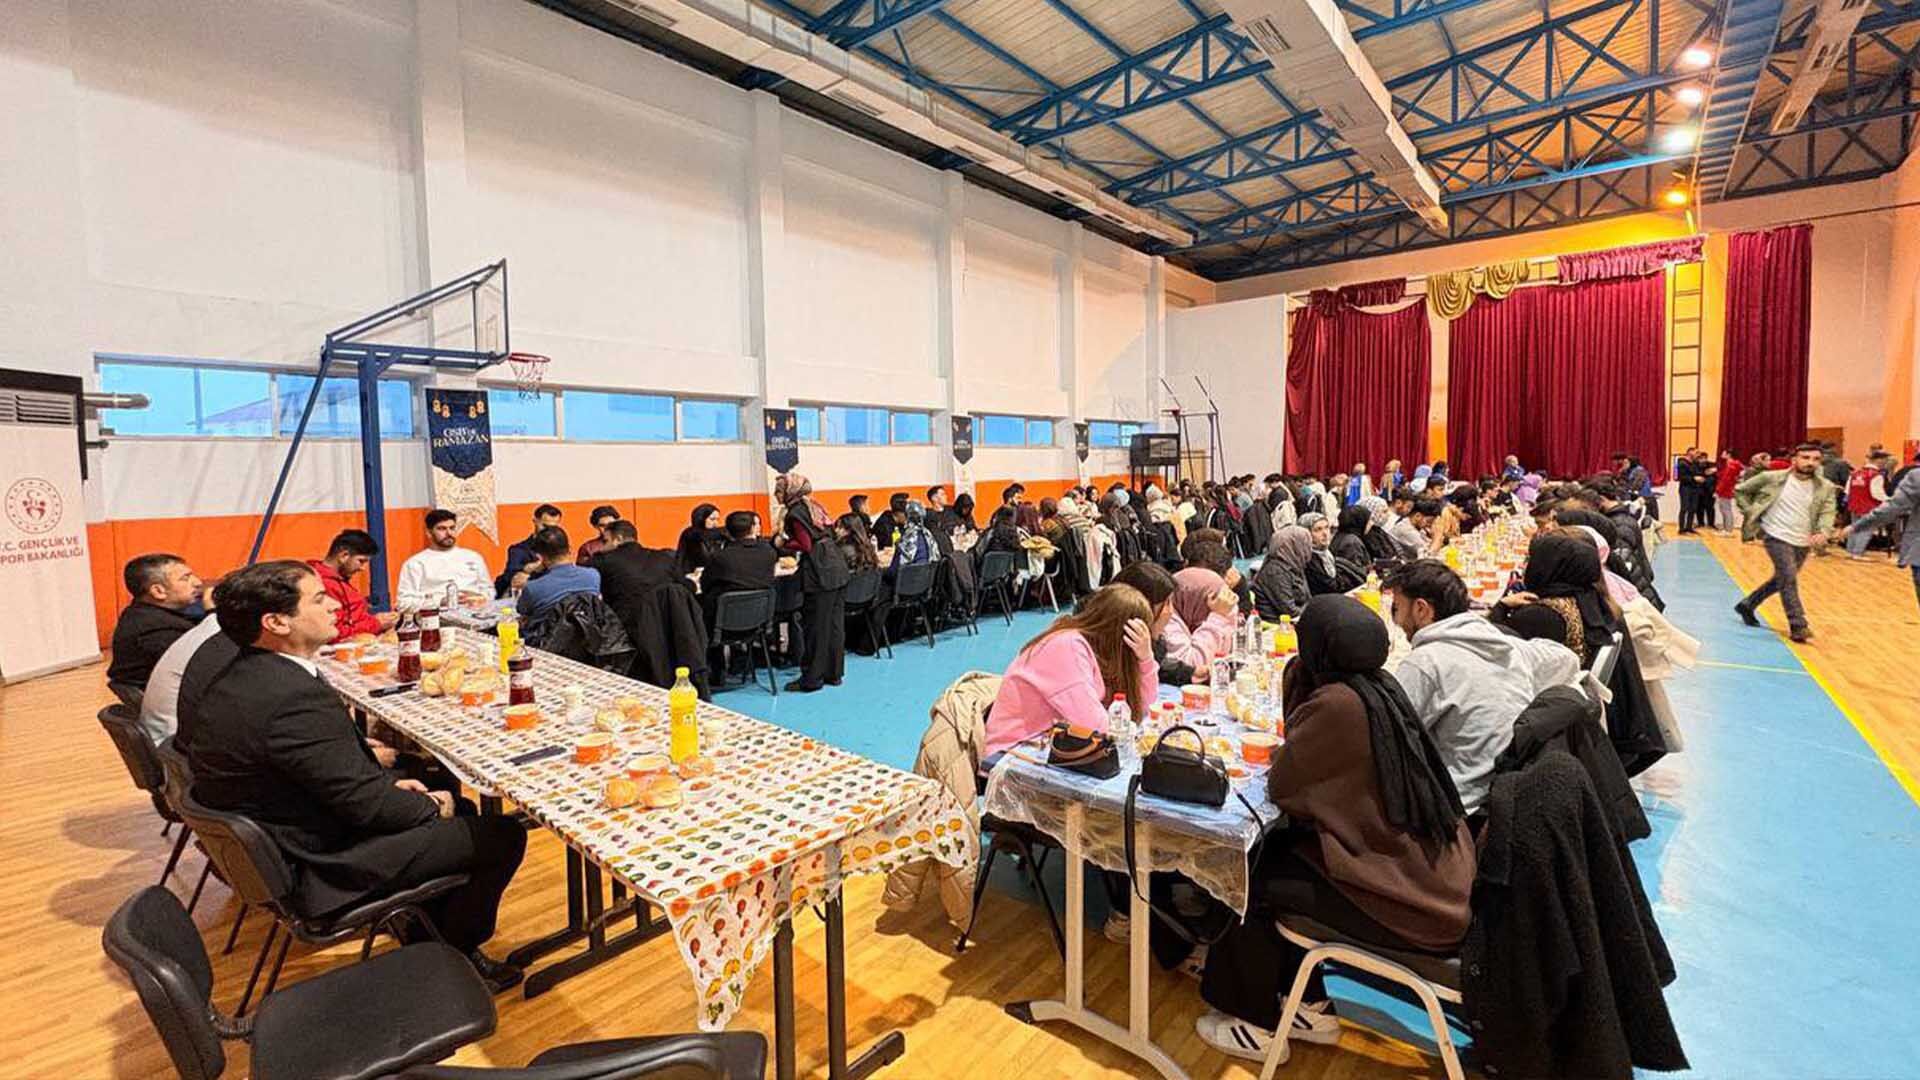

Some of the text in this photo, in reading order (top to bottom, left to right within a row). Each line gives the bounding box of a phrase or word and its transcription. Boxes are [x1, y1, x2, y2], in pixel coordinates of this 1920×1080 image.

[65, 535, 79, 545] VE
[0, 546, 84, 565] POR BAKANLIĞI
